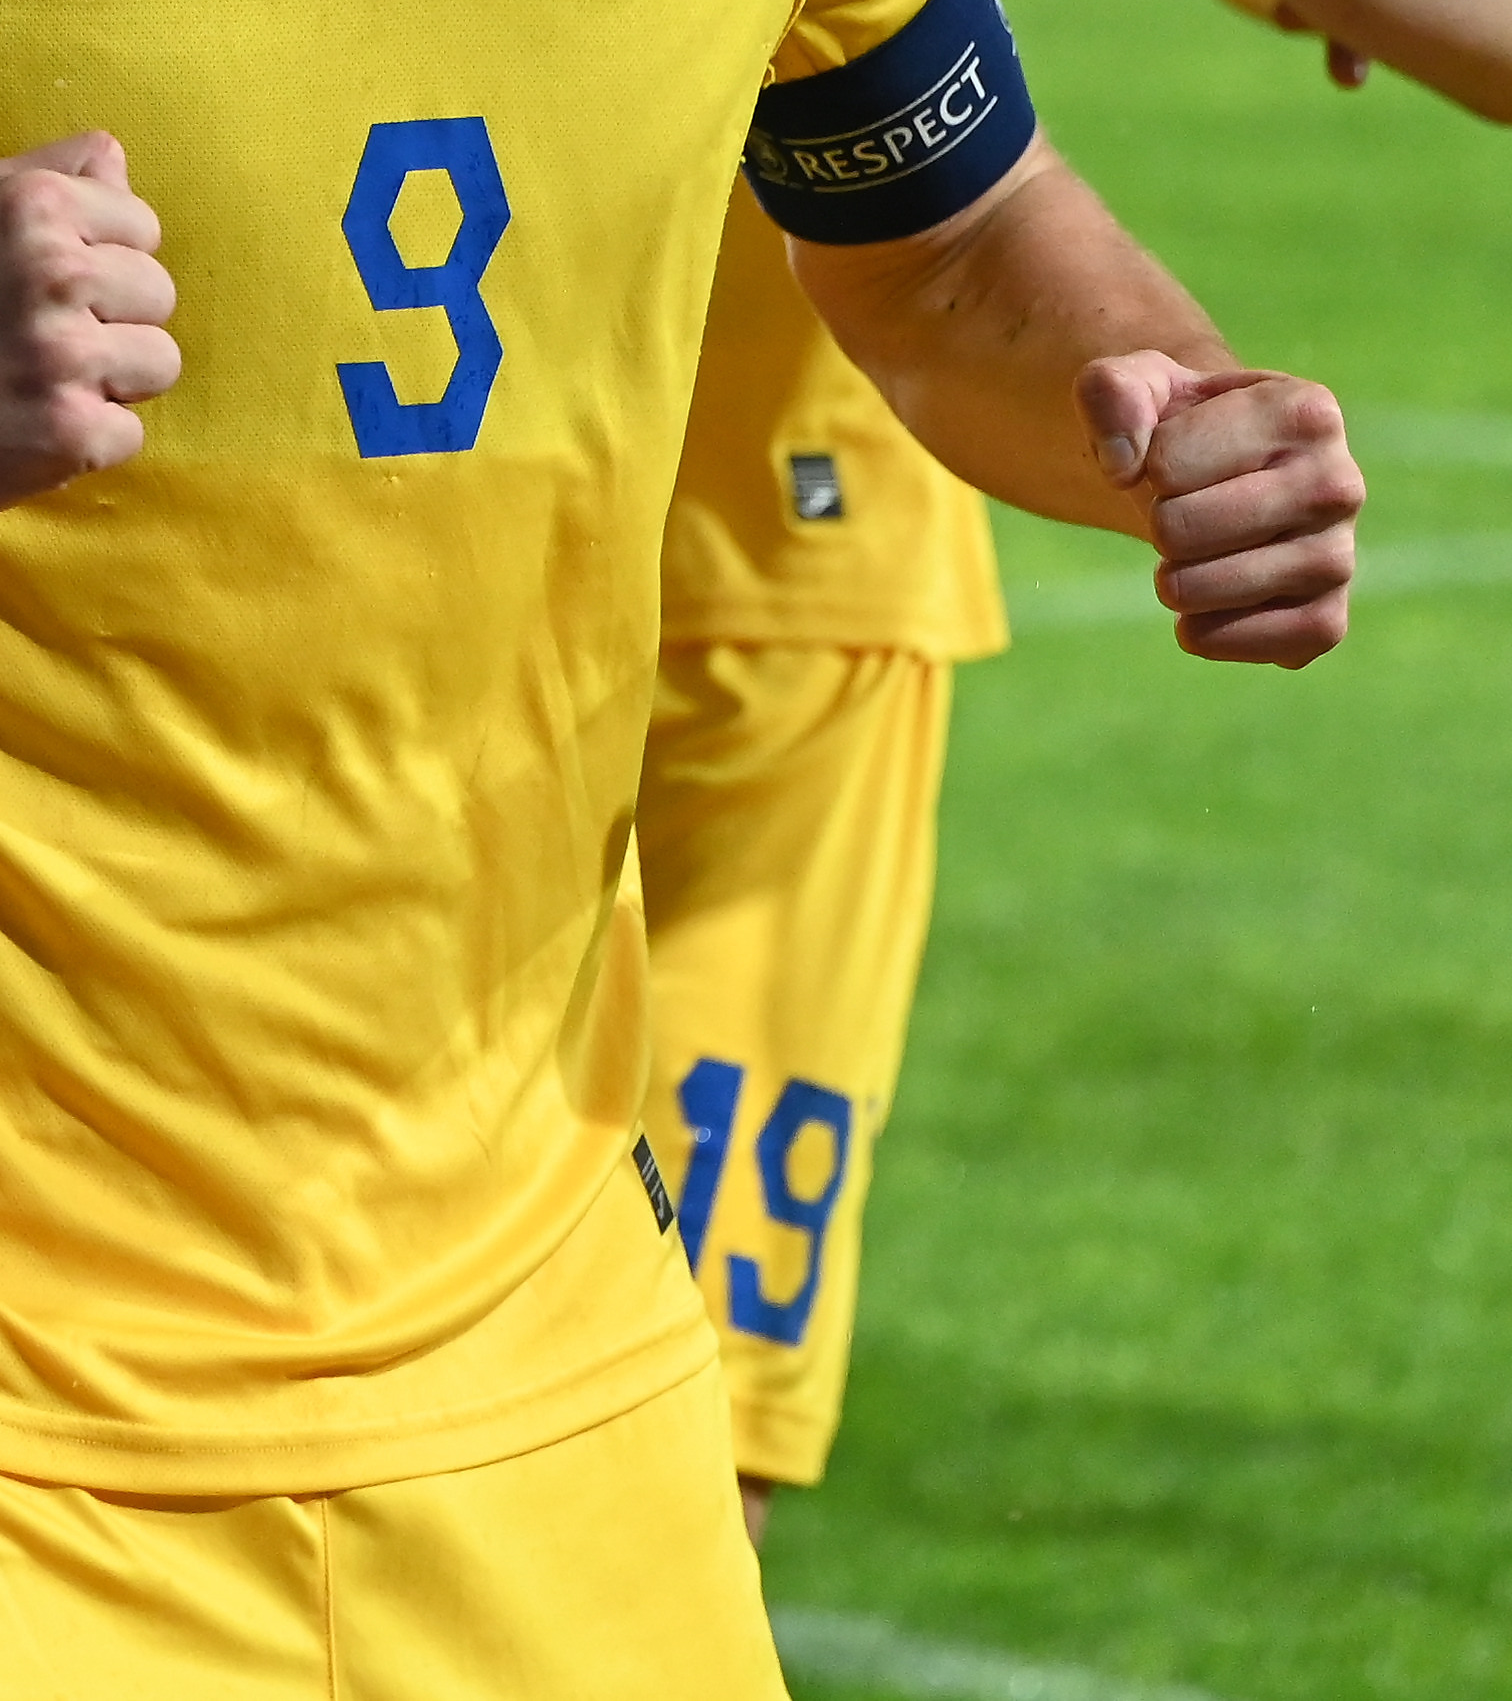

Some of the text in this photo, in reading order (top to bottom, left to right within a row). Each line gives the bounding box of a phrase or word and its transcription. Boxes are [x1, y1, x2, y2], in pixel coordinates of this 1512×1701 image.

[792, 56, 987, 181] RESPECT
[337, 116, 513, 459] 9
[676, 1057, 853, 1347] 19
